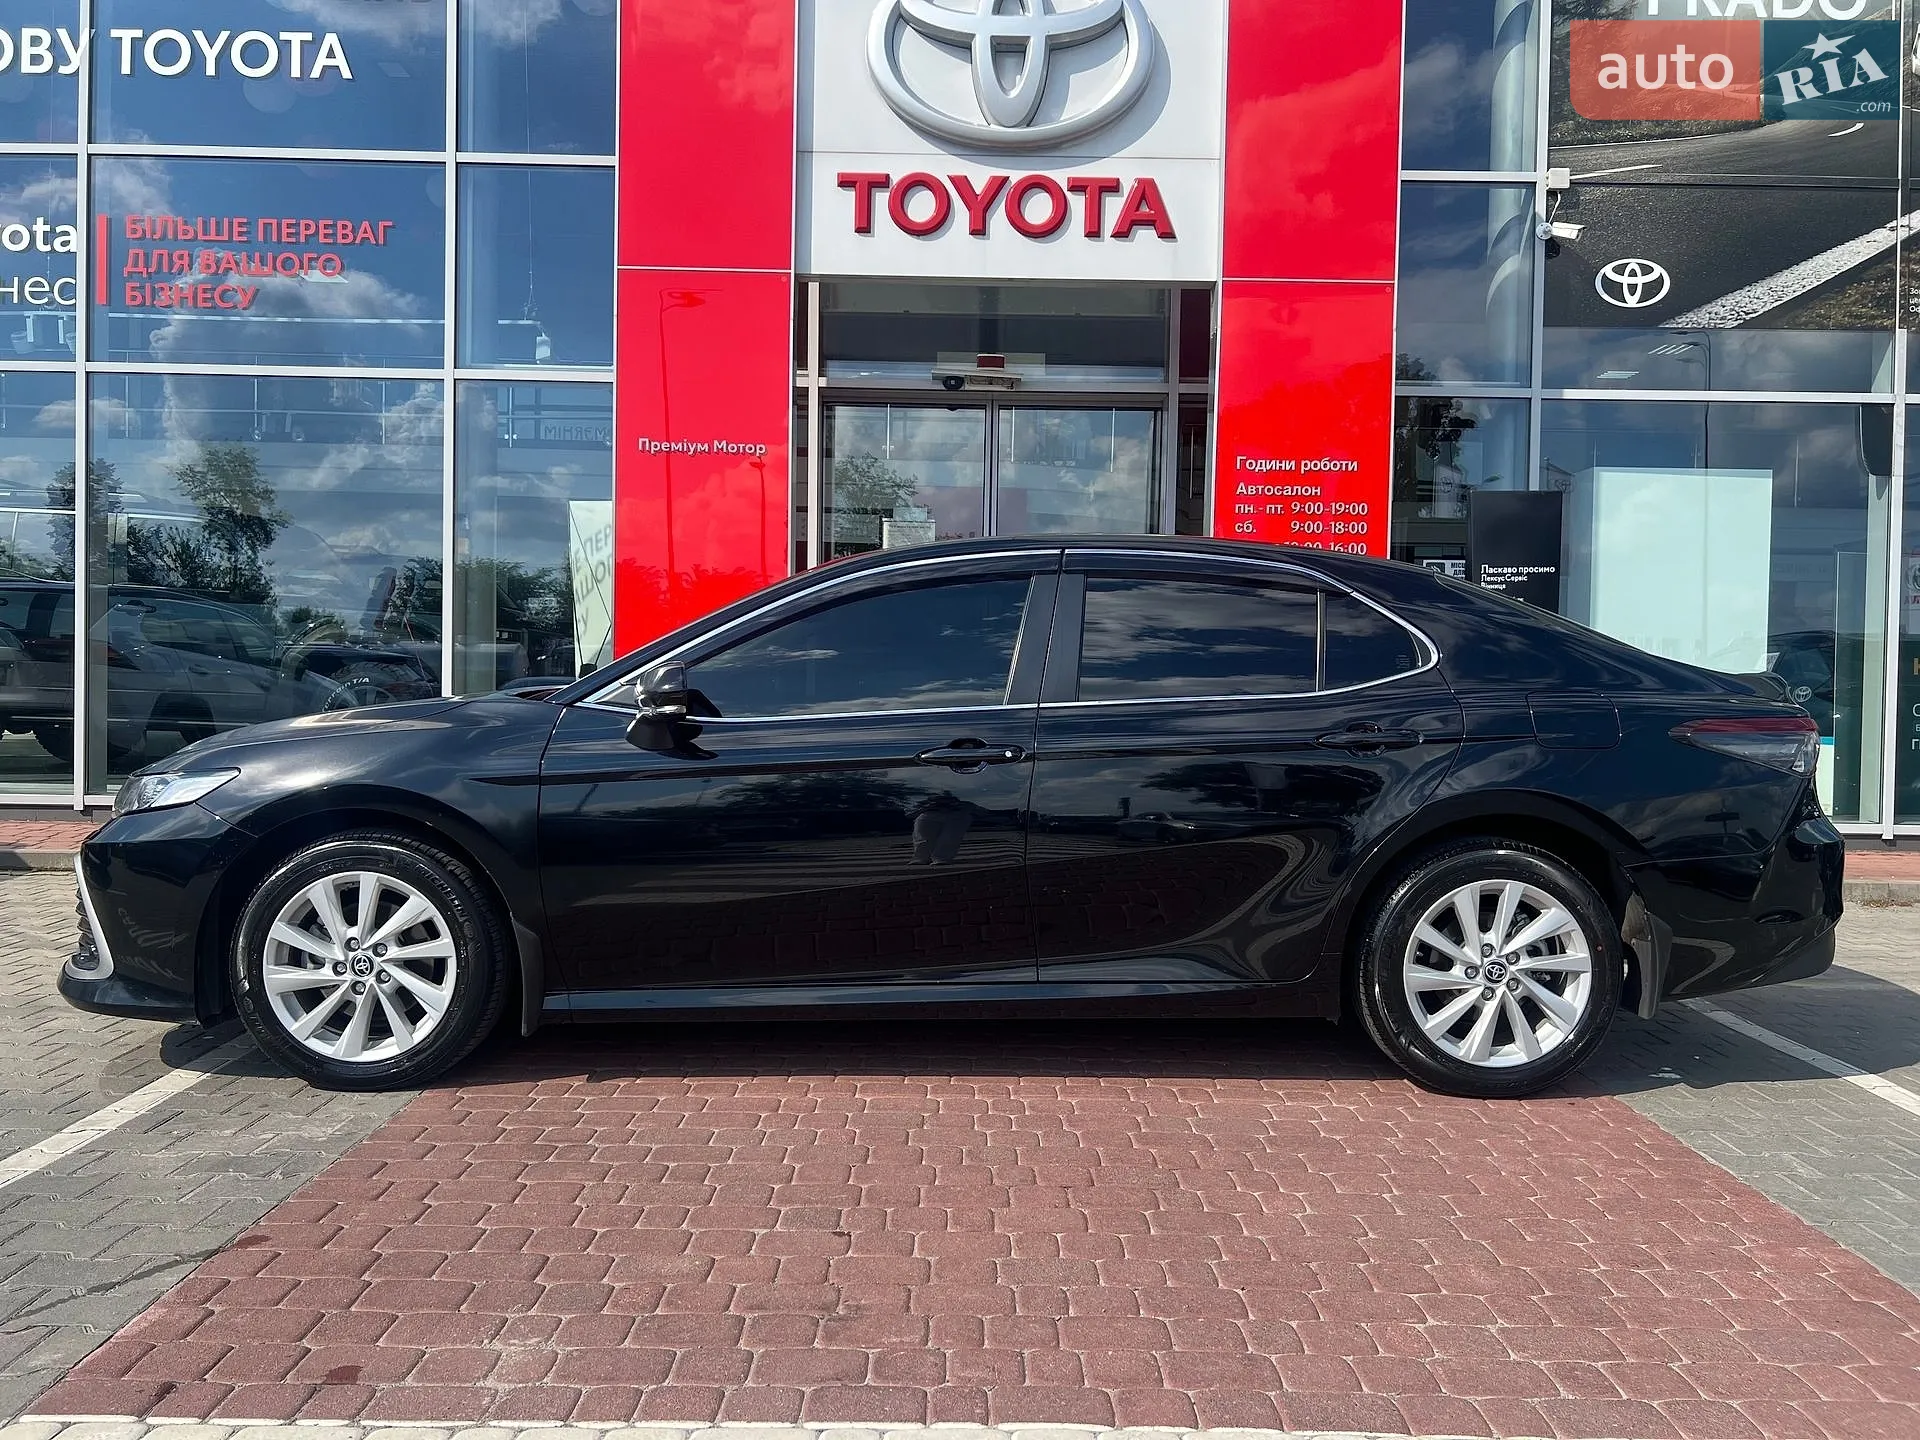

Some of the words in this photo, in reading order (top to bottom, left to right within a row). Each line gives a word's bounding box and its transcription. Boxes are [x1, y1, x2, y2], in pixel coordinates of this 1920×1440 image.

[0, 27, 95, 75] ВУ
[110, 28, 353, 80] TOYOTA
[836, 171, 1177, 239] TOYOTA
[0, 216, 77, 253] ota
[125, 215, 249, 242] БІЛЬШЕ
[258, 218, 394, 245] ПЕРЕВАГ
[123, 248, 190, 277] ДЛЯ
[199, 250, 343, 277] ВАШОГО
[125, 282, 257, 310] БІЗНЕСУ
[638, 438, 709, 455] Преміум
[713, 440, 766, 456] Мотор
[1236, 455, 1296, 473] Години
[1300, 457, 1358, 474] роботи
[1236, 482, 1321, 496] Автосалон
[1290, 501, 1368, 515] 9:00-19:00
[1235, 520, 1257, 533] сб.
[1290, 520, 1368, 534] 9:00-18:00
[1480, 564, 1517, 574] Ласкаво
[1518, 566, 1555, 575] просимо
[1480, 574, 1505, 583] Лексус
[1505, 573, 1528, 583] Сервіс
